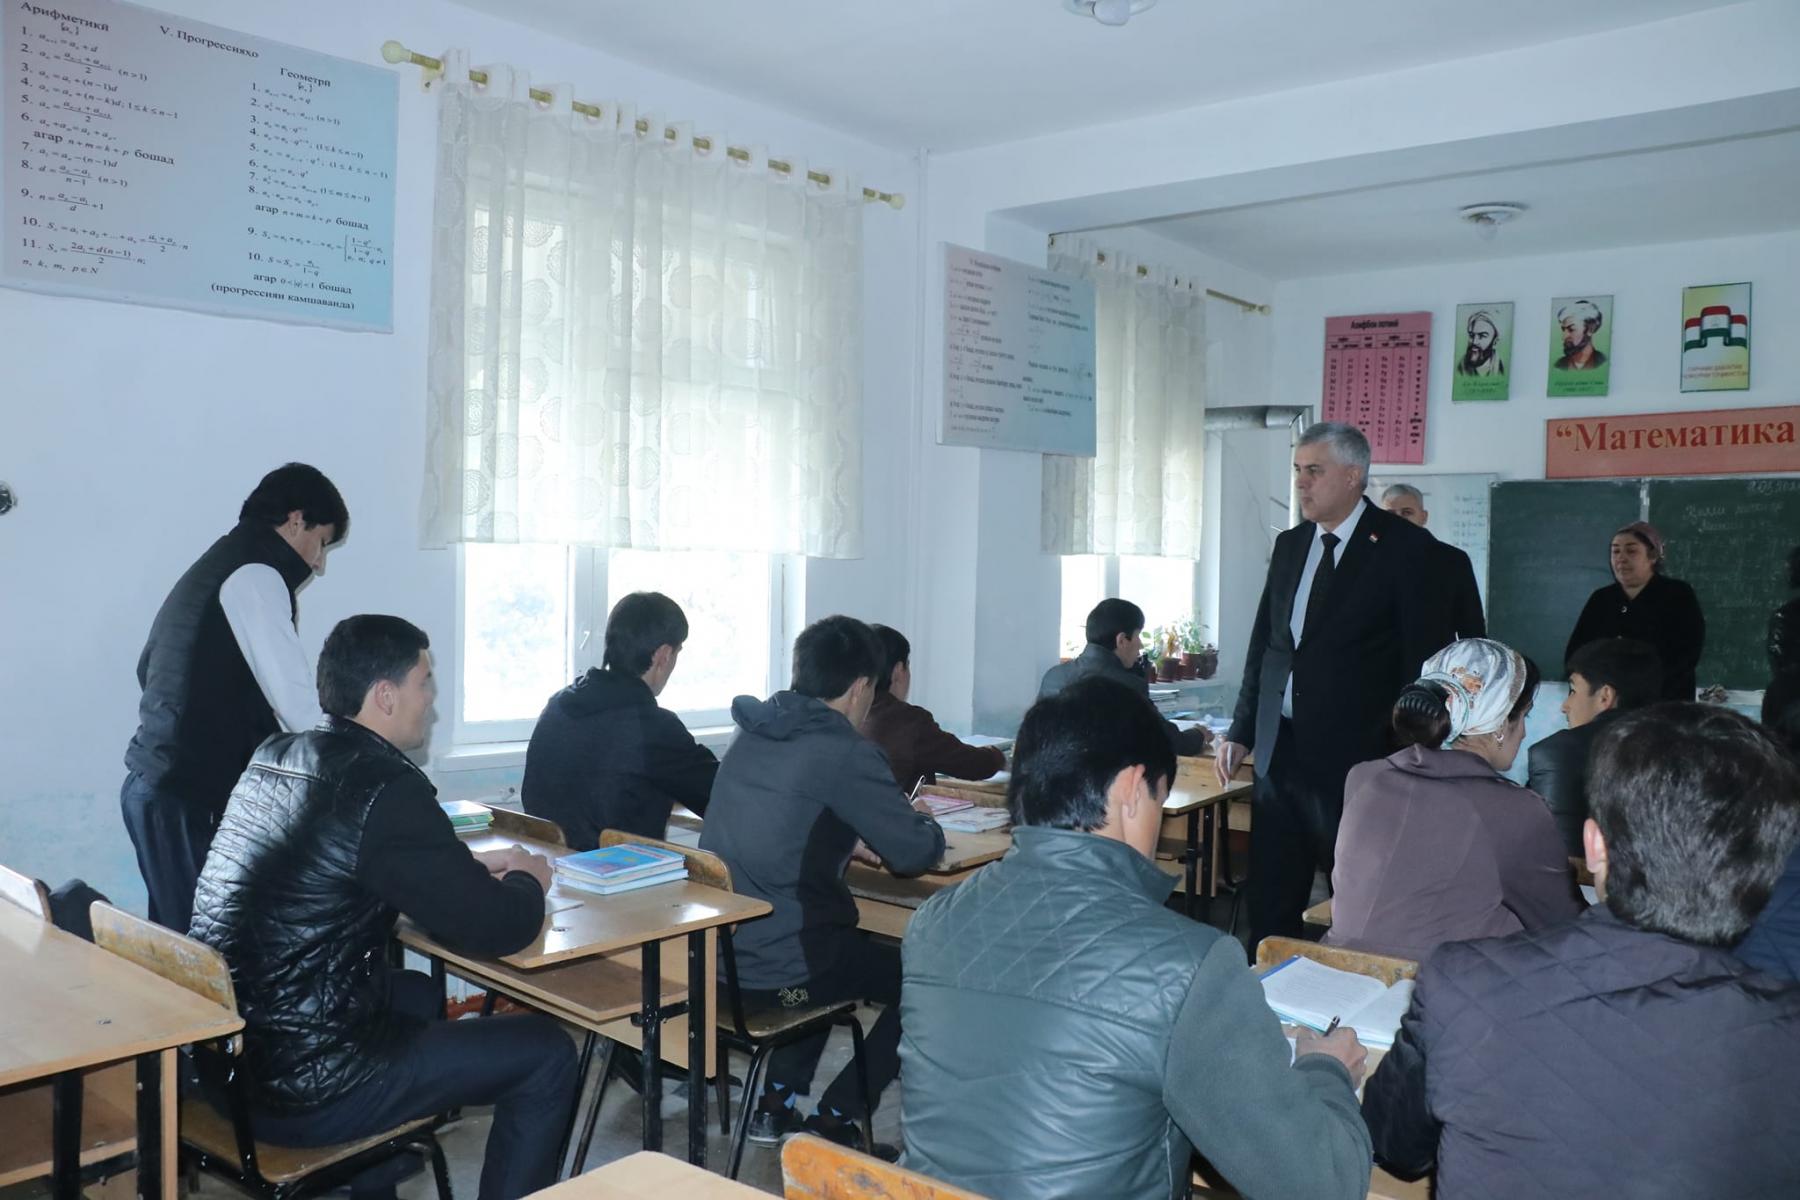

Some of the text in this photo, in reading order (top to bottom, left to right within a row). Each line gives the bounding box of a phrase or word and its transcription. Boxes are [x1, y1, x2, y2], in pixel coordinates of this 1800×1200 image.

[33, 130, 63, 144] агар
[255, 204, 278, 215] агар
[22, 216, 41, 228] 10.
[22, 238, 41, 249] 11.
[248, 252, 263, 262] 10.
[253, 273, 277, 284] агар
